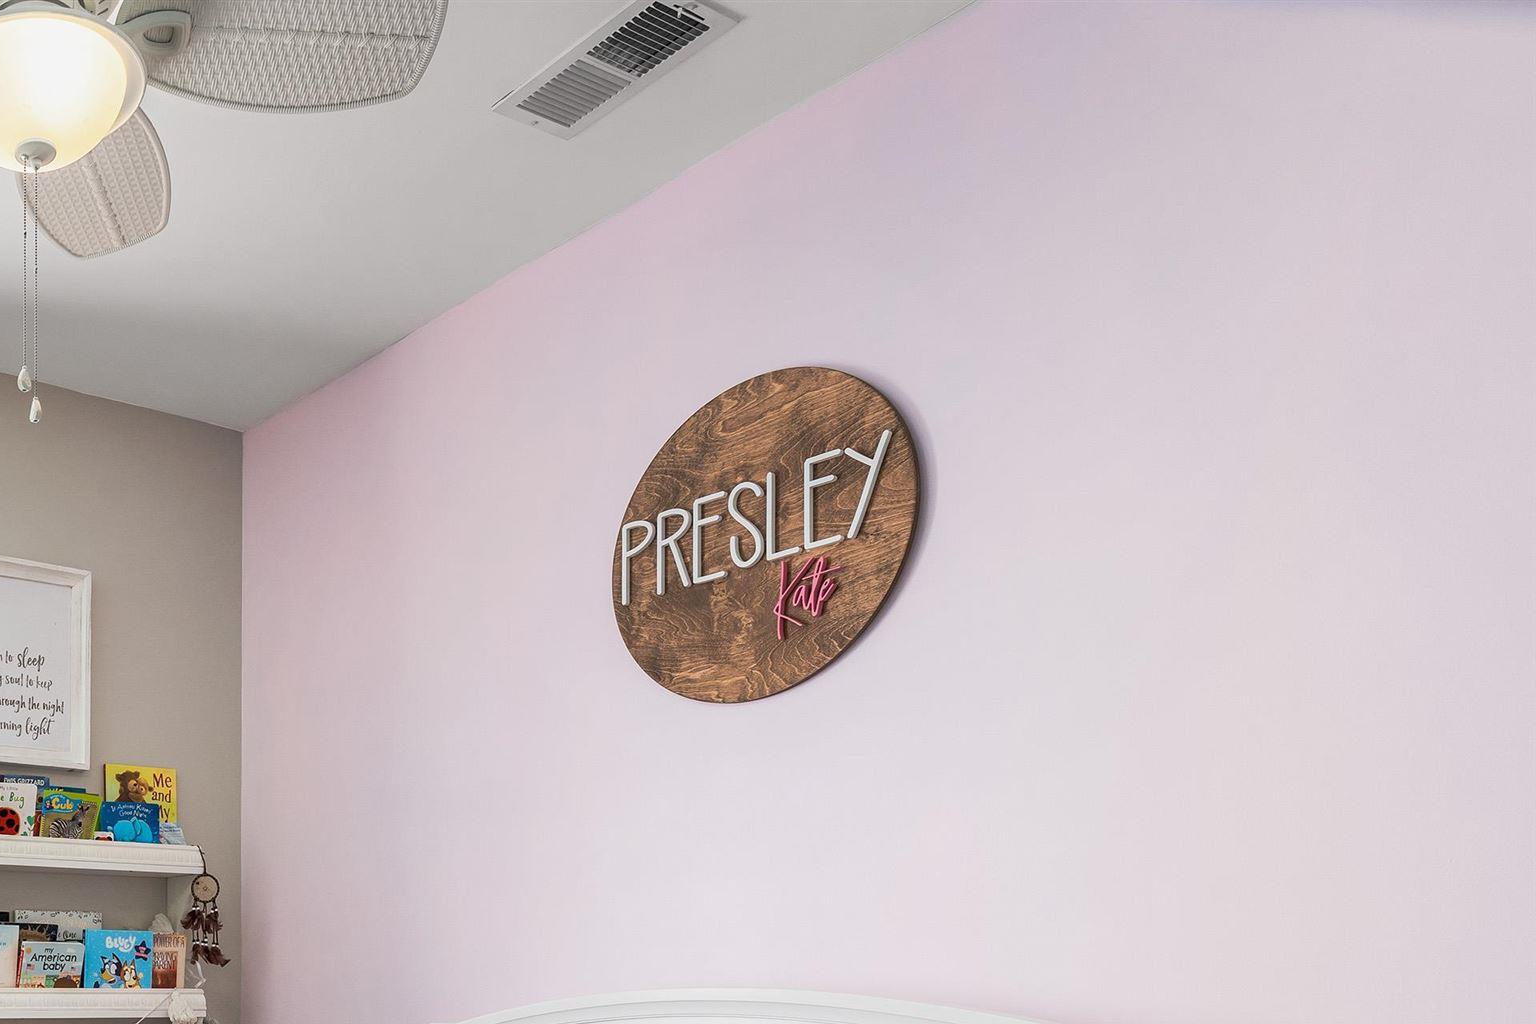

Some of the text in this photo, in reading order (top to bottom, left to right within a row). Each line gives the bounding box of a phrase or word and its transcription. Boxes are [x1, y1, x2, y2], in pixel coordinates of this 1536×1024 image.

[621, 430, 892, 606] PRESLEY
[773, 556, 842, 641] Kate
[5, 650, 13, 663] to
[17, 647, 45, 672] sleep
[5, 673, 24, 686] soul
[26, 675, 34, 688] to
[36, 676, 52, 691] keep
[28, 697, 40, 711] the
[42, 700, 64, 717] night
[26, 717, 55, 740] light
[153, 773, 172, 790] Me
[9, 792, 24, 808] Bug
[152, 790, 171, 803] and
[30, 953, 77, 962] American
[45, 947, 54, 955] my
[43, 962, 65, 972] baby
